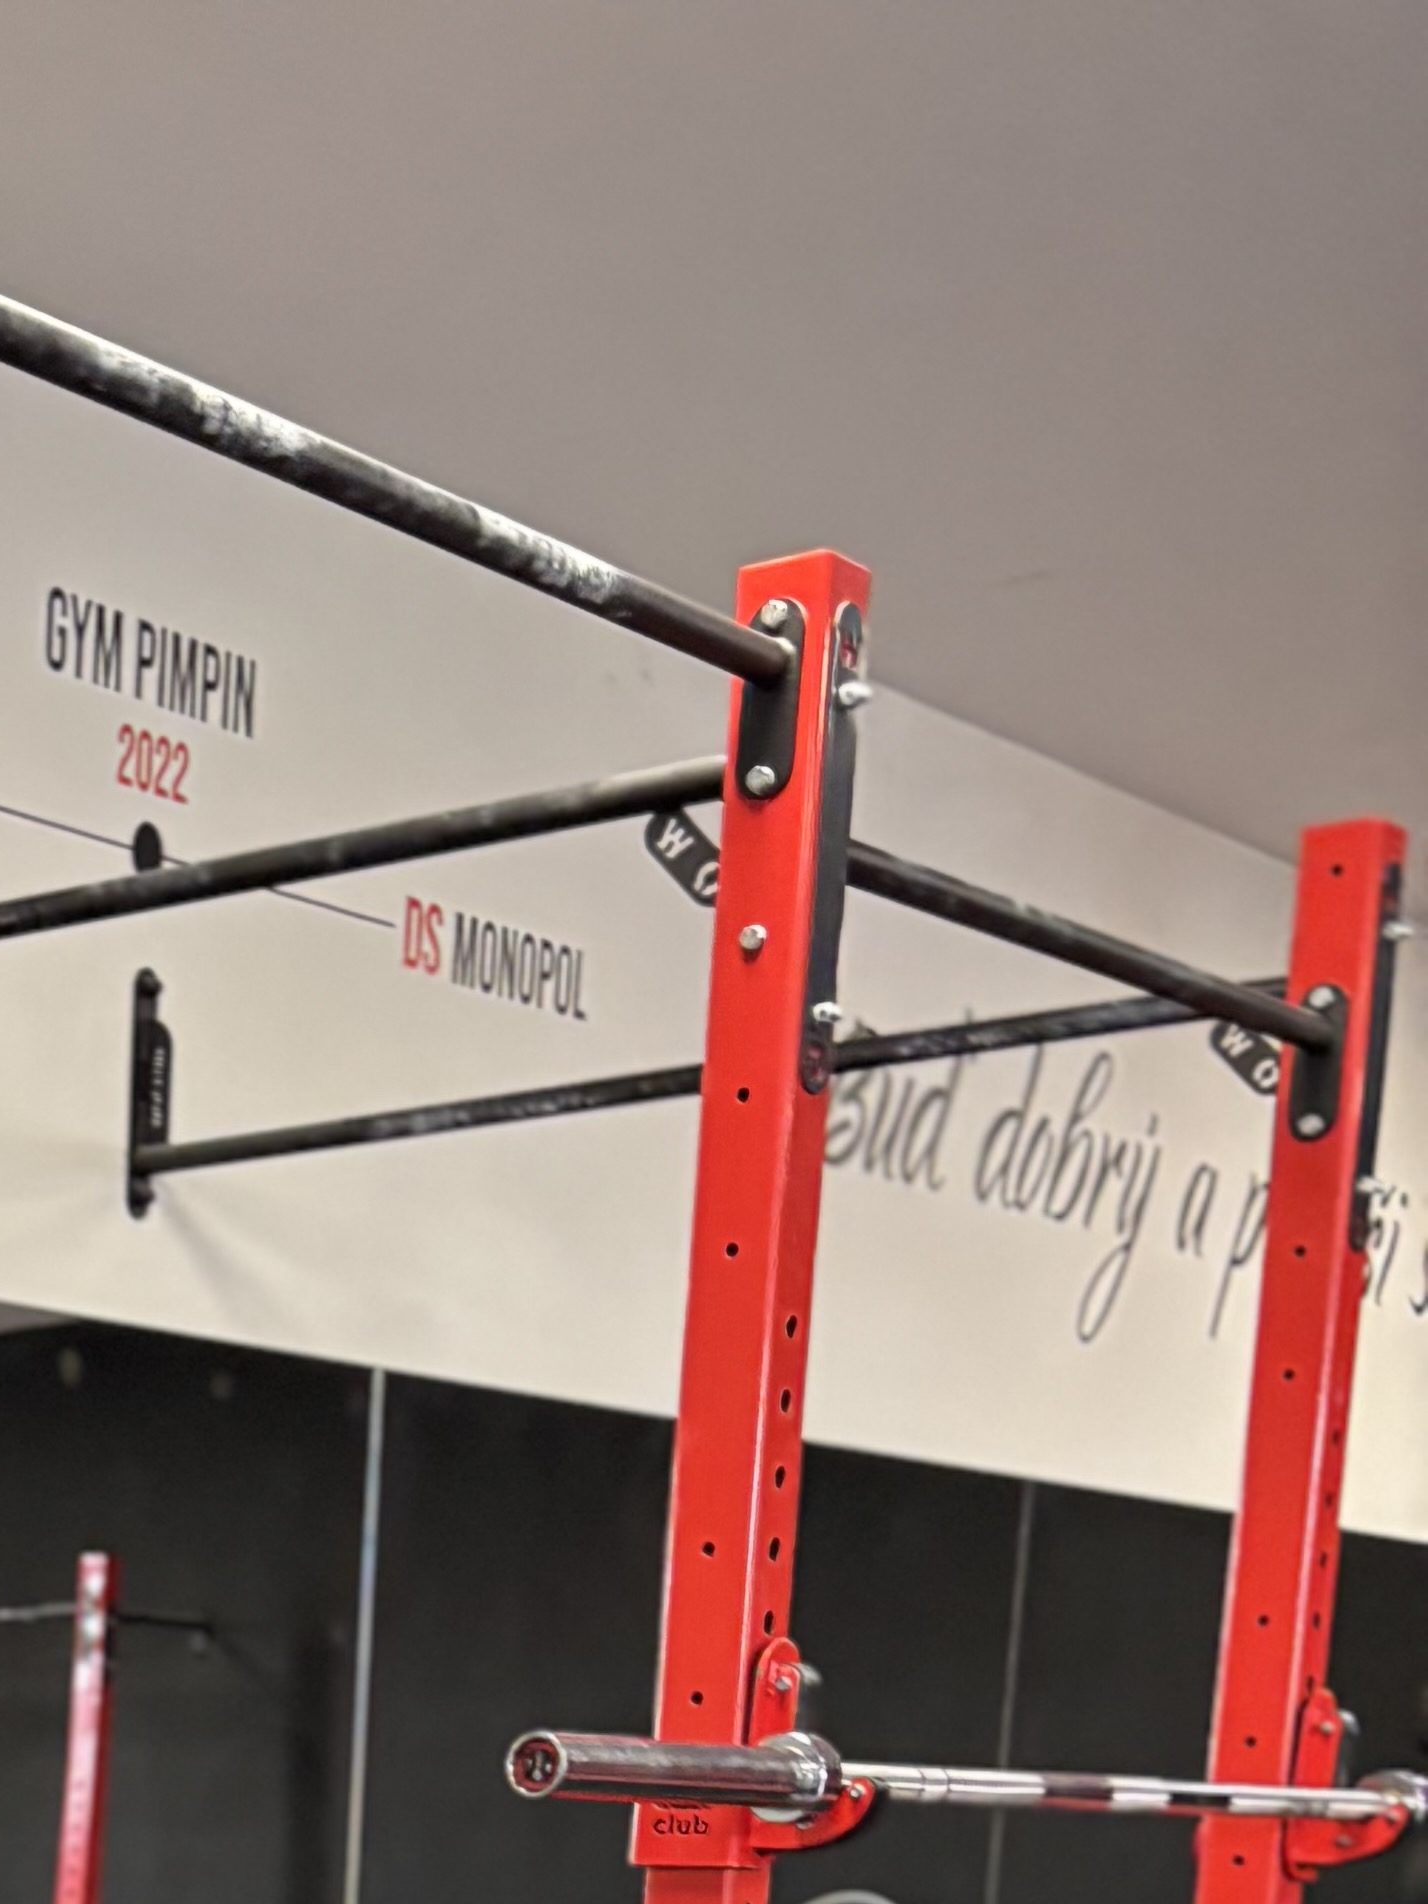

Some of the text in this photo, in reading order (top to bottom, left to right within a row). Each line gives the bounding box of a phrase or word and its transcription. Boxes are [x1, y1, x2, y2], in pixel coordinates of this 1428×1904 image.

[46, 586, 257, 740] GYM PIMPIN
[116, 723, 190, 806] 2022
[402, 895, 587, 1022] DS MONOPOL
